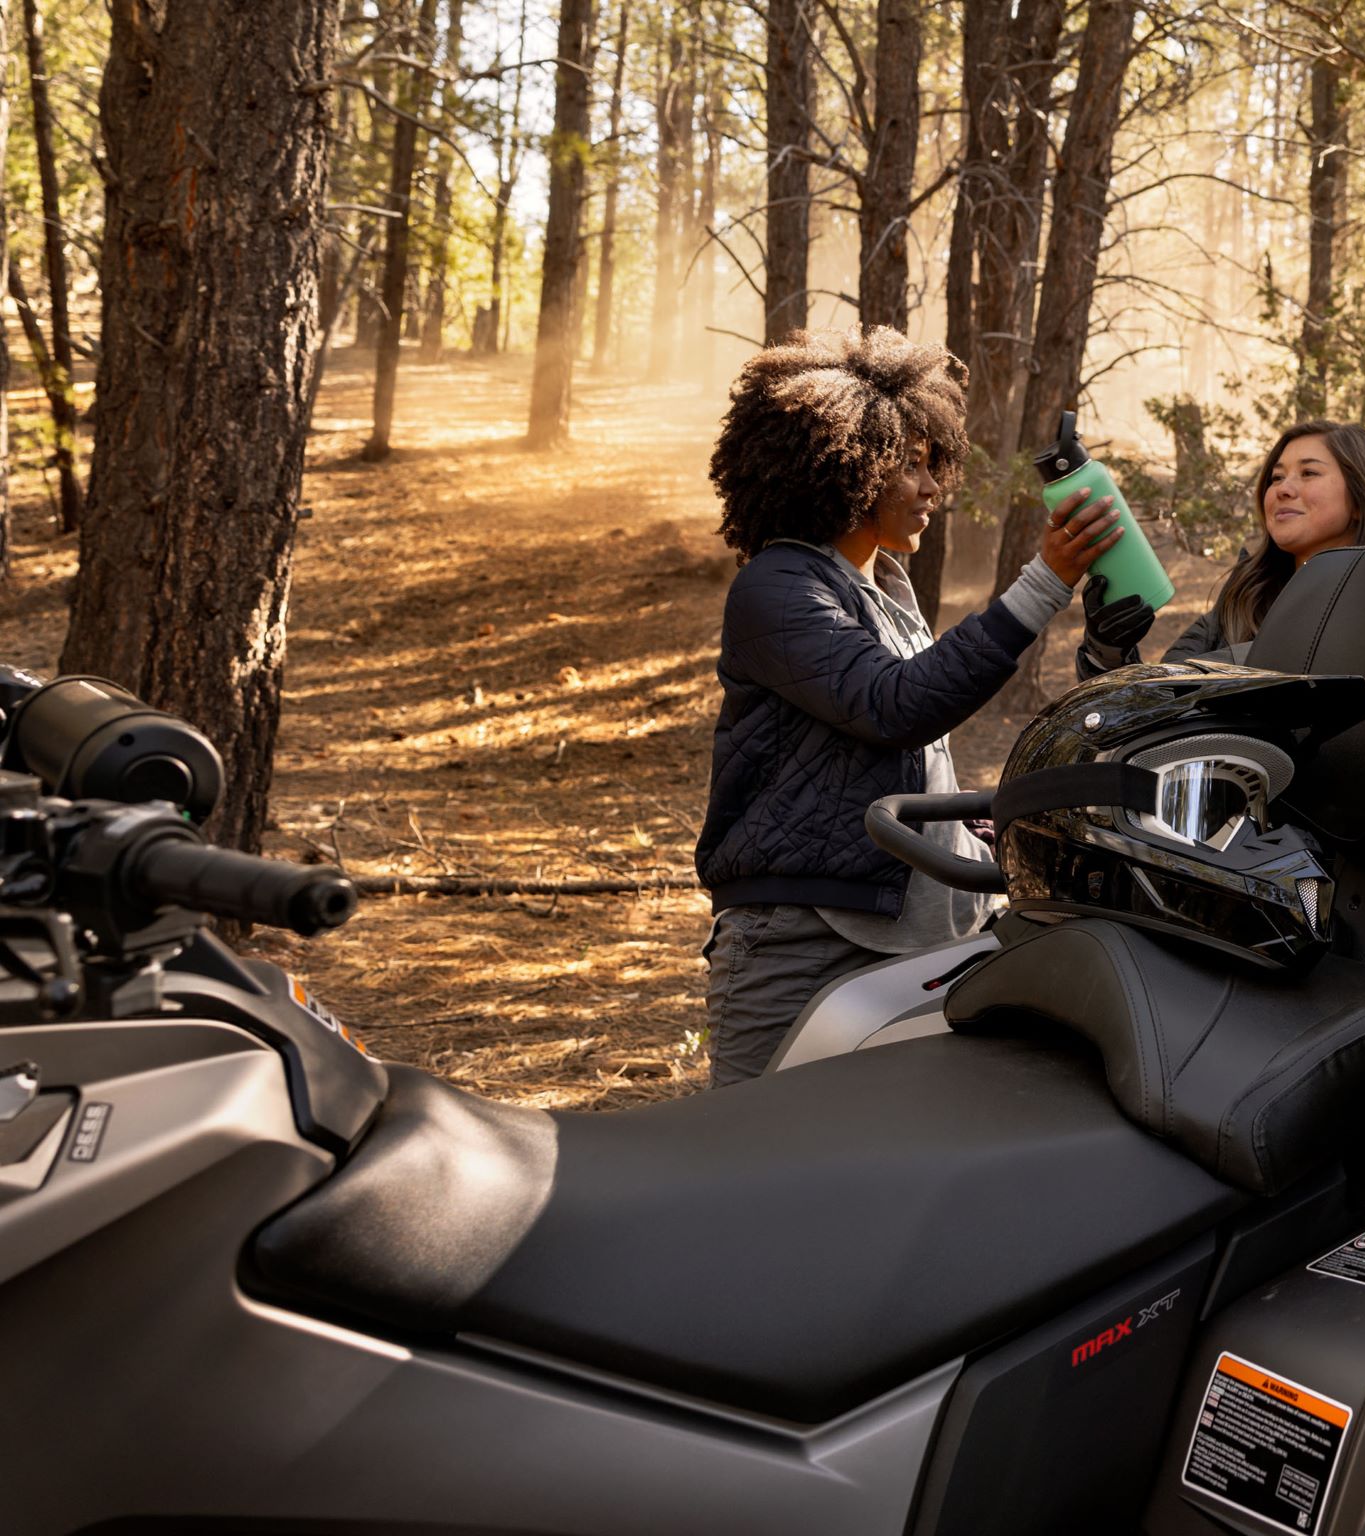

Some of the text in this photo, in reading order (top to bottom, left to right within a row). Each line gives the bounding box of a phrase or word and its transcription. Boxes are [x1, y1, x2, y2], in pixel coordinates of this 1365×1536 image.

[1072, 1288, 1180, 1368] MAX XT
[1269, 1383, 1299, 1401] WARNING
